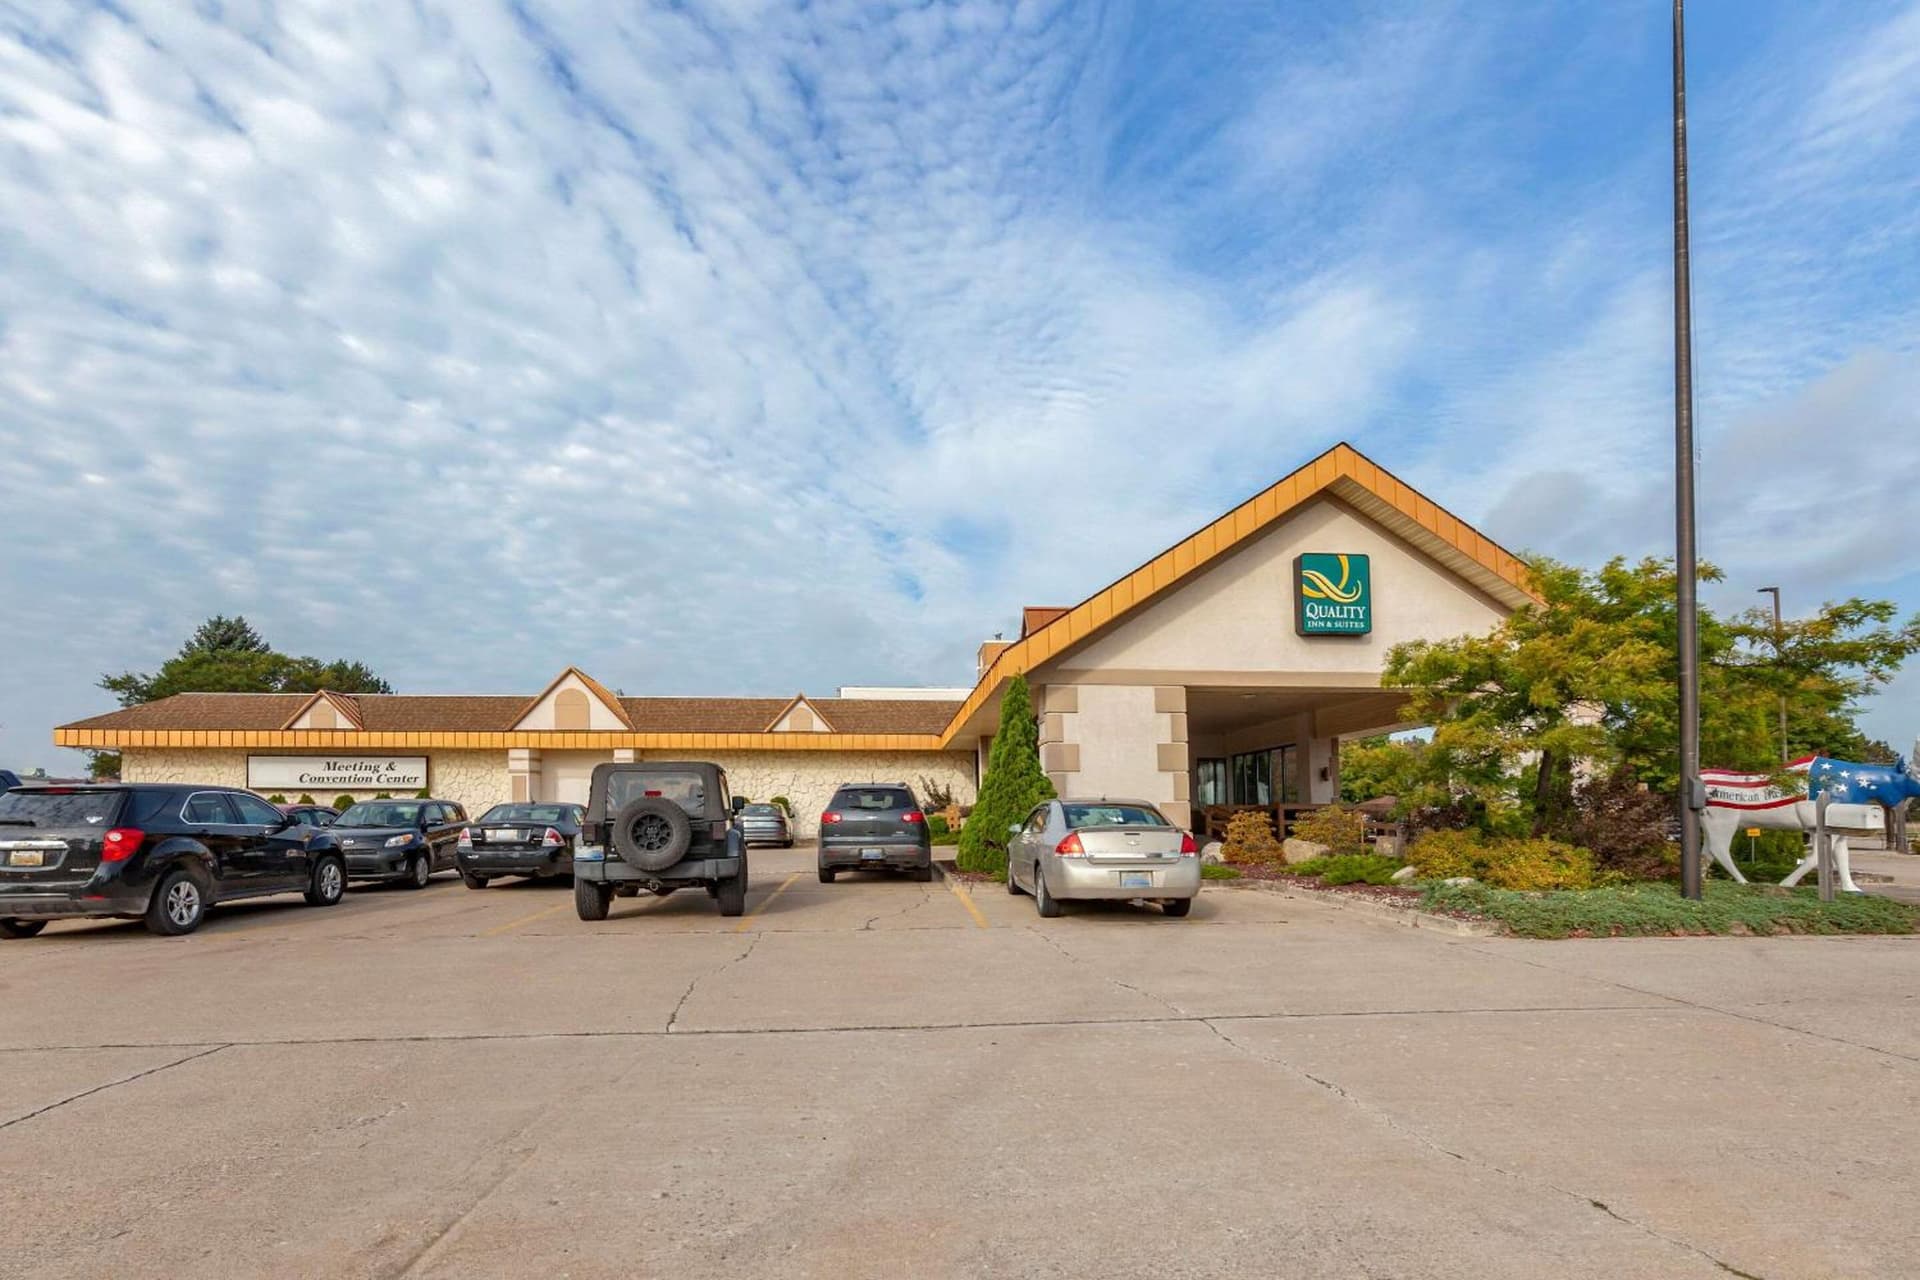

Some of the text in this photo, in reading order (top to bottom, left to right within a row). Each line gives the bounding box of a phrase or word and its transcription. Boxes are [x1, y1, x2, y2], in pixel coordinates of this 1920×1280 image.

[1306, 602, 1366, 619] QUALITY
[1334, 621, 1365, 629] SUITES
[324, 761, 397, 774] Meeting &
[299, 772, 420, 784] Convention Center
